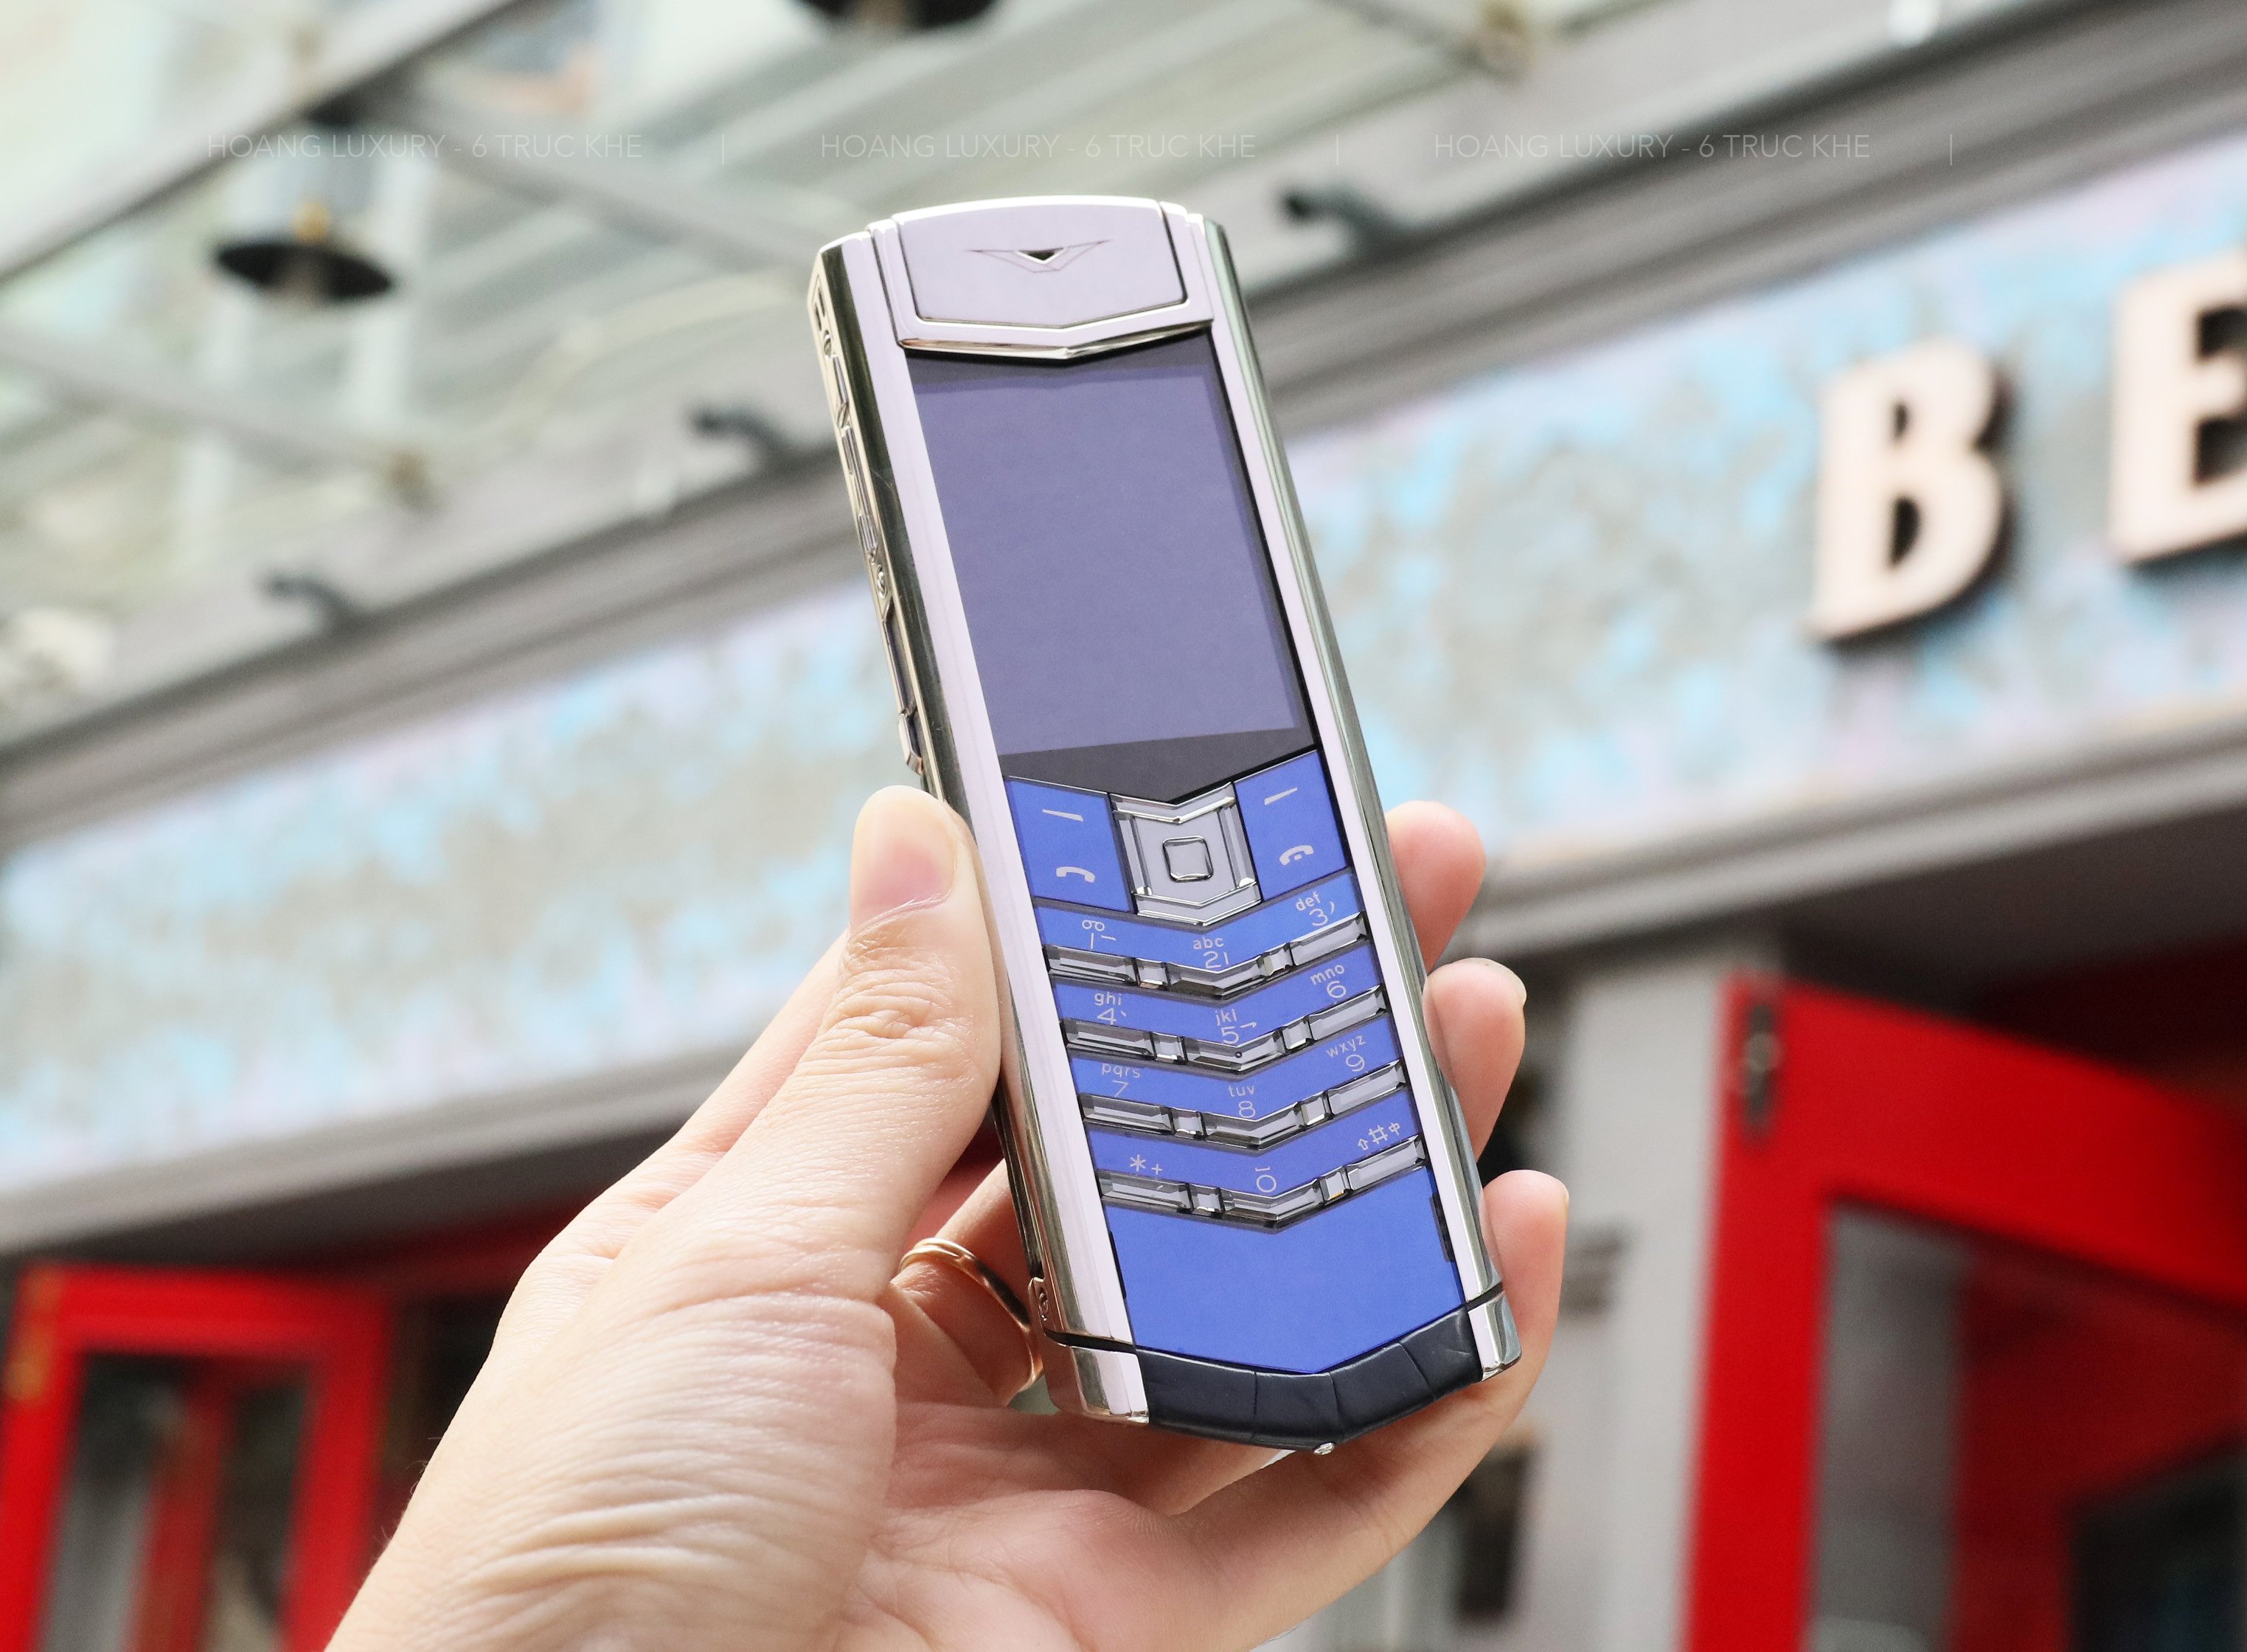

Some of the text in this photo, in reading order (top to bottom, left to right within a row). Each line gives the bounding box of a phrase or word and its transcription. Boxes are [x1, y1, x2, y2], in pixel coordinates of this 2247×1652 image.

[1295, 891, 1322, 912] def
[1192, 937, 1224, 950] abc
[1309, 964, 1345, 986] mno
[1326, 980, 1347, 999] 6
[1094, 992, 1122, 1007] ghi
[1215, 1009, 1237, 1027] jkl
[1326, 1035, 1366, 1058] wxyz
[1102, 1063, 1142, 1078] pqrs
[1346, 1054, 1365, 1072] 9
[1112, 1080, 1129, 1097] 7
[1228, 1085, 1255, 1097] tuv
[1238, 1100, 1256, 1119] 8
